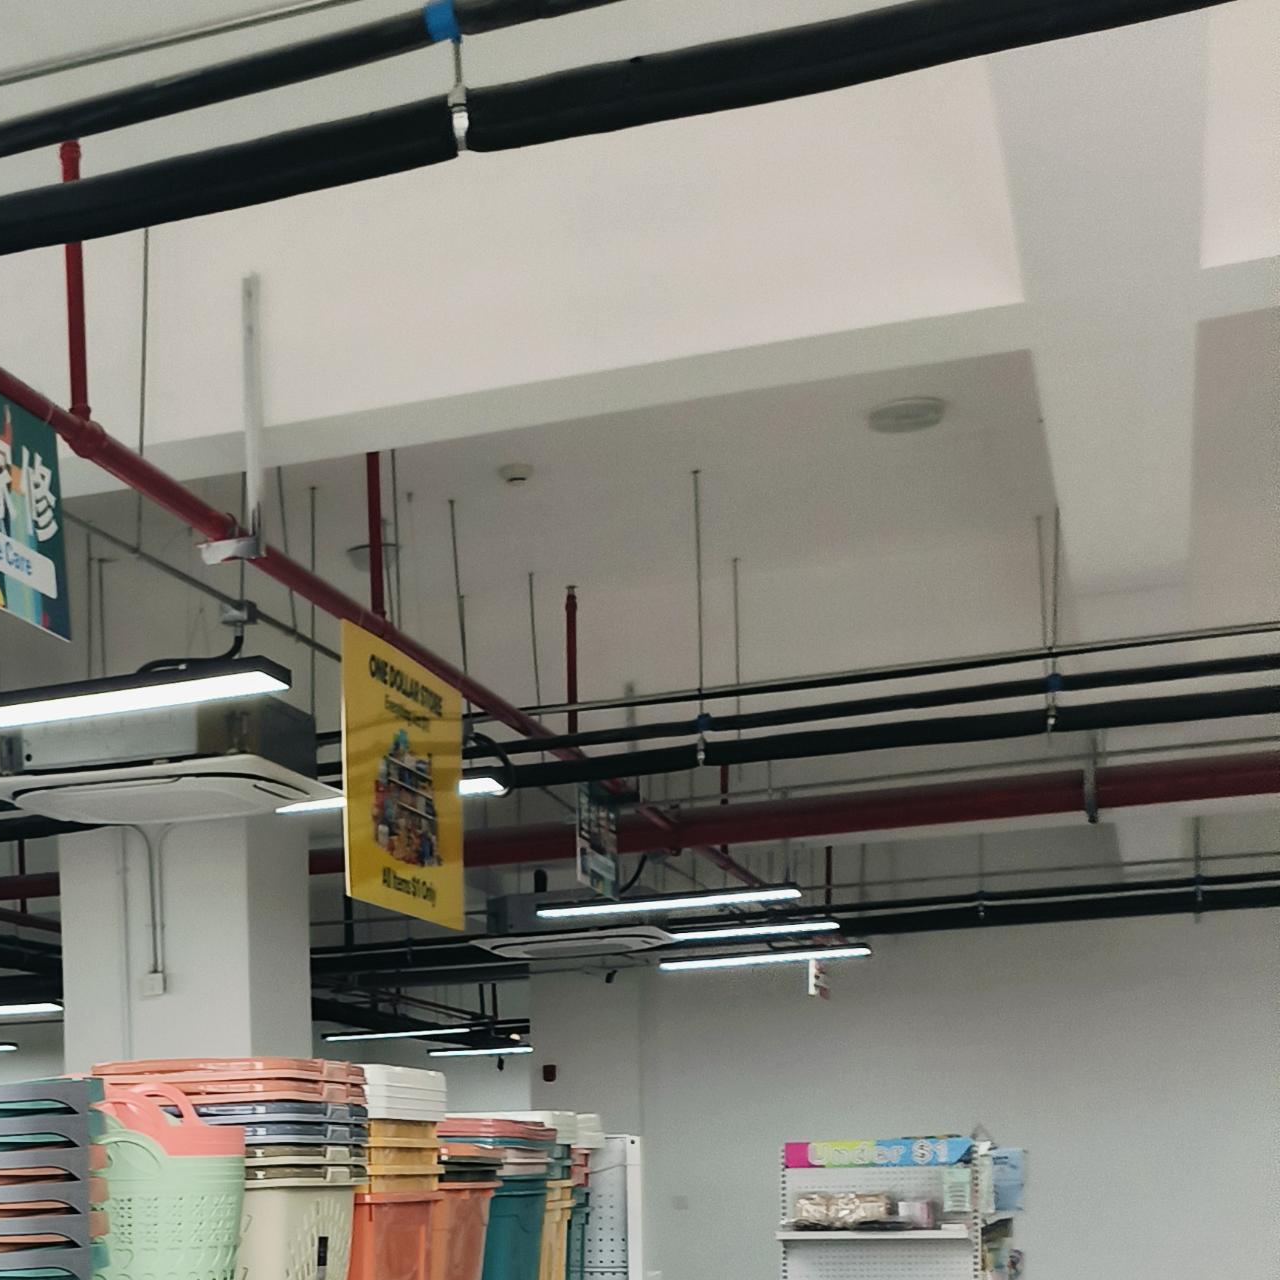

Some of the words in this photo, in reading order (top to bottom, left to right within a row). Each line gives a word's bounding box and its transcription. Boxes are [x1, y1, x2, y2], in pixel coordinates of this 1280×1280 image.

[5, 545, 32, 577] Care
[368, 653, 388, 686] ONE
[389, 664, 419, 703] DOLLAR
[807, 1142, 905, 1166] Under
[911, 1139, 950, 1165] $1
